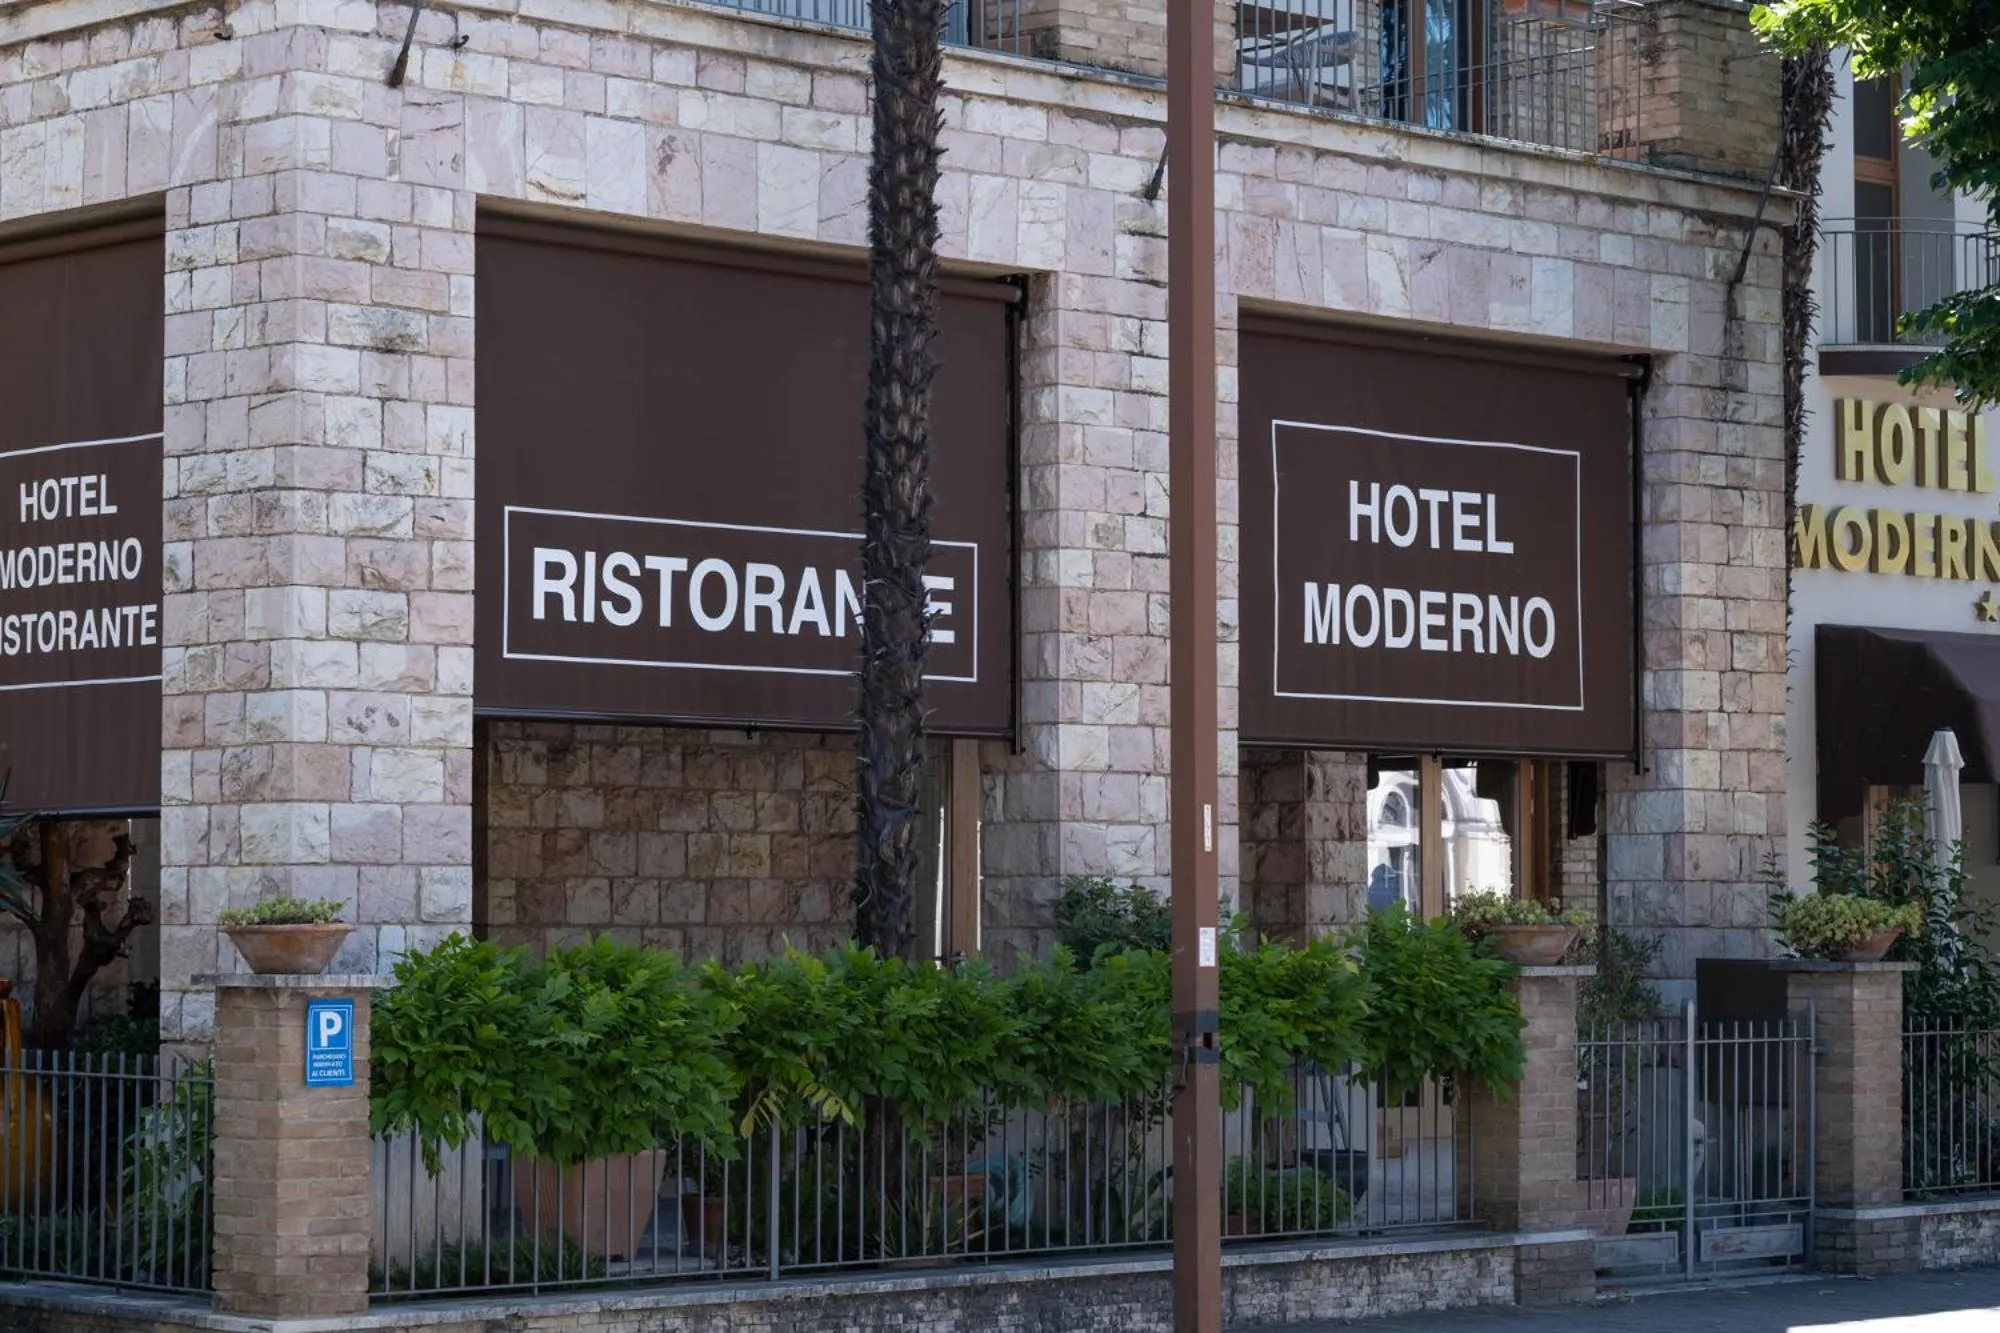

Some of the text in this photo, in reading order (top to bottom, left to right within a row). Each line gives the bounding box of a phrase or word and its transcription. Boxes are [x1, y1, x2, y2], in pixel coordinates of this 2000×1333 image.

[1837, 398, 1996, 493] HOTEL
[20, 474, 117, 522] HOTEL
[1350, 480, 1514, 554] HOTEL
[0, 537, 142, 589] MODERNO
[533, 546, 955, 644] RISTORANE
[1304, 581, 1556, 659] MODERNO
[320, 1011, 342, 1048] P
